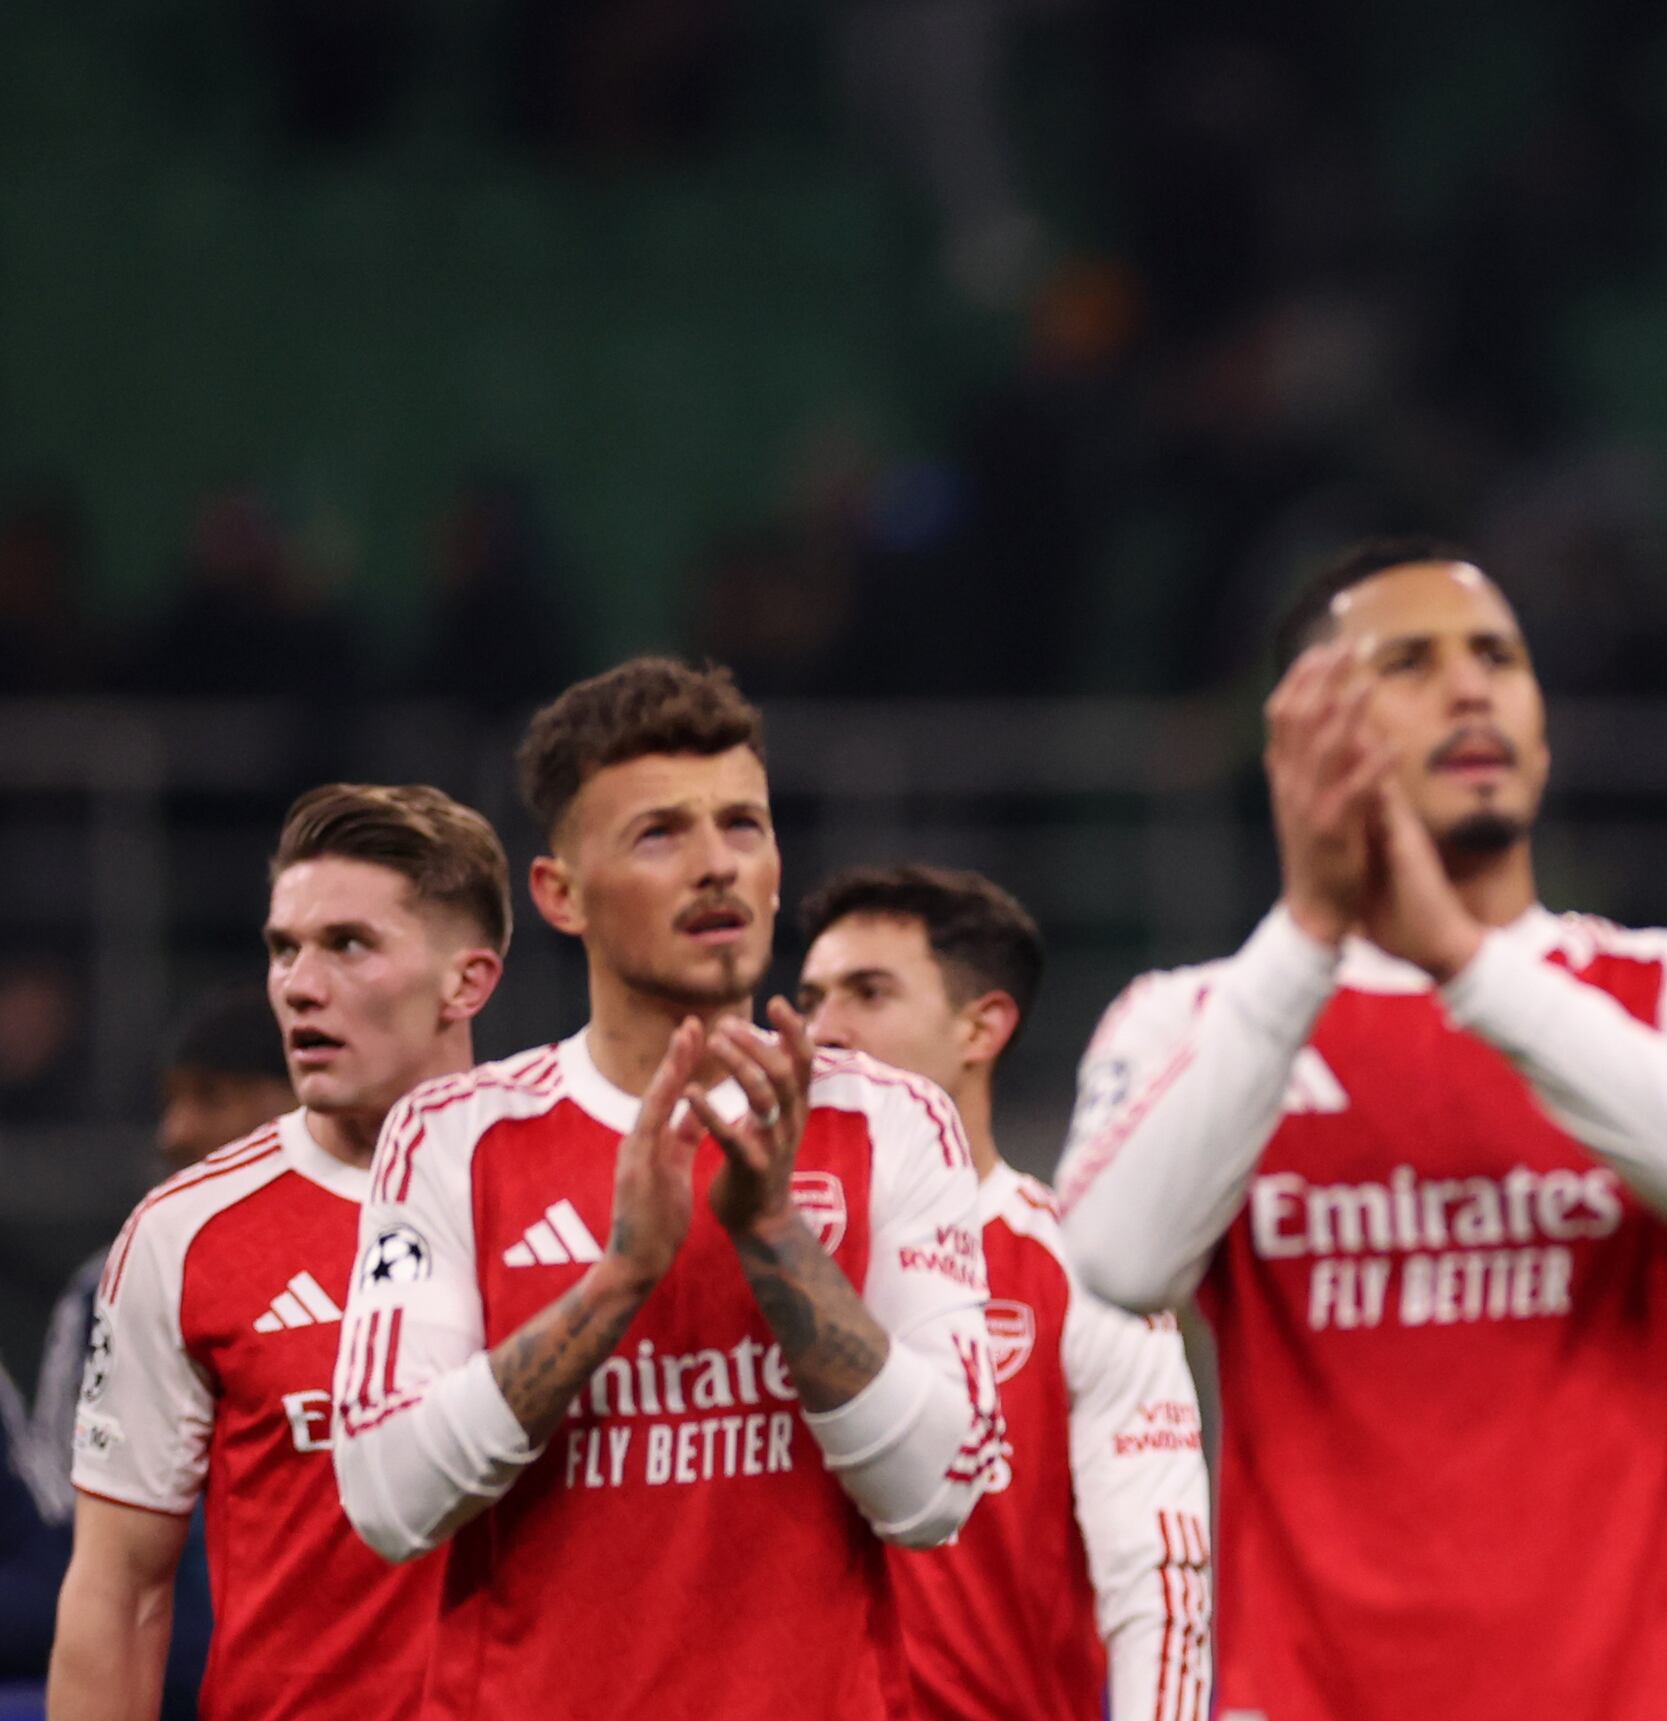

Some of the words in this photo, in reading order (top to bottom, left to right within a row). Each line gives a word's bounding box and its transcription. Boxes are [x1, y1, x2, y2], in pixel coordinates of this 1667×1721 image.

[1250, 1165, 1622, 1260] Emirates
[1308, 1256, 1391, 1331] FLY
[1399, 1246, 1574, 1327] BETTER
[567, 1336, 799, 1417] mirate
[566, 1424, 632, 1489] FLY
[646, 1410, 794, 1486] BETTER
